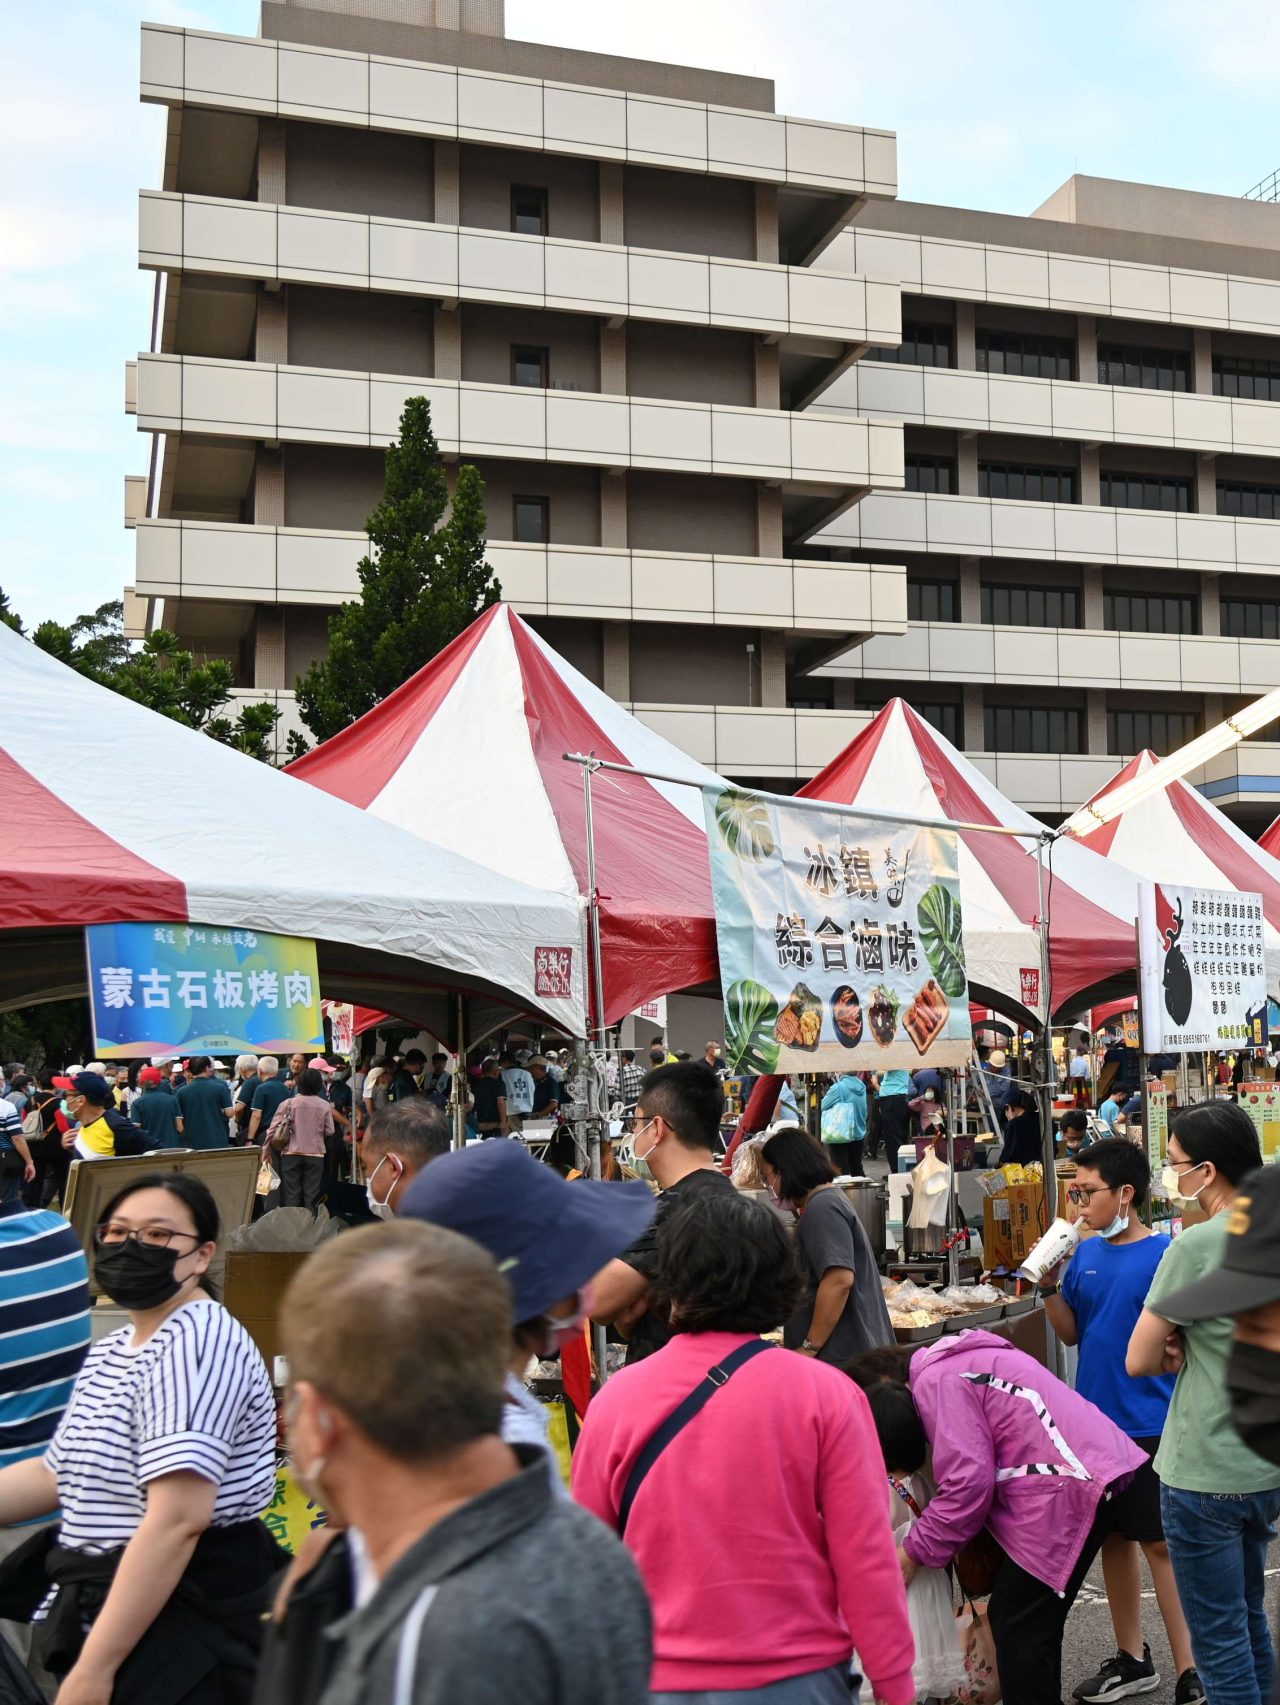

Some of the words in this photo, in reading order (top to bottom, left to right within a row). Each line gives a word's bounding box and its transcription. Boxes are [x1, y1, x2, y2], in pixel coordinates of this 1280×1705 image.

[803, 843, 879, 900] 冰鎮
[182, 926, 206, 946] 中鋼
[775, 911, 919, 974] 綜合滷味
[100, 966, 313, 1009] 蒙古石板烤肉
